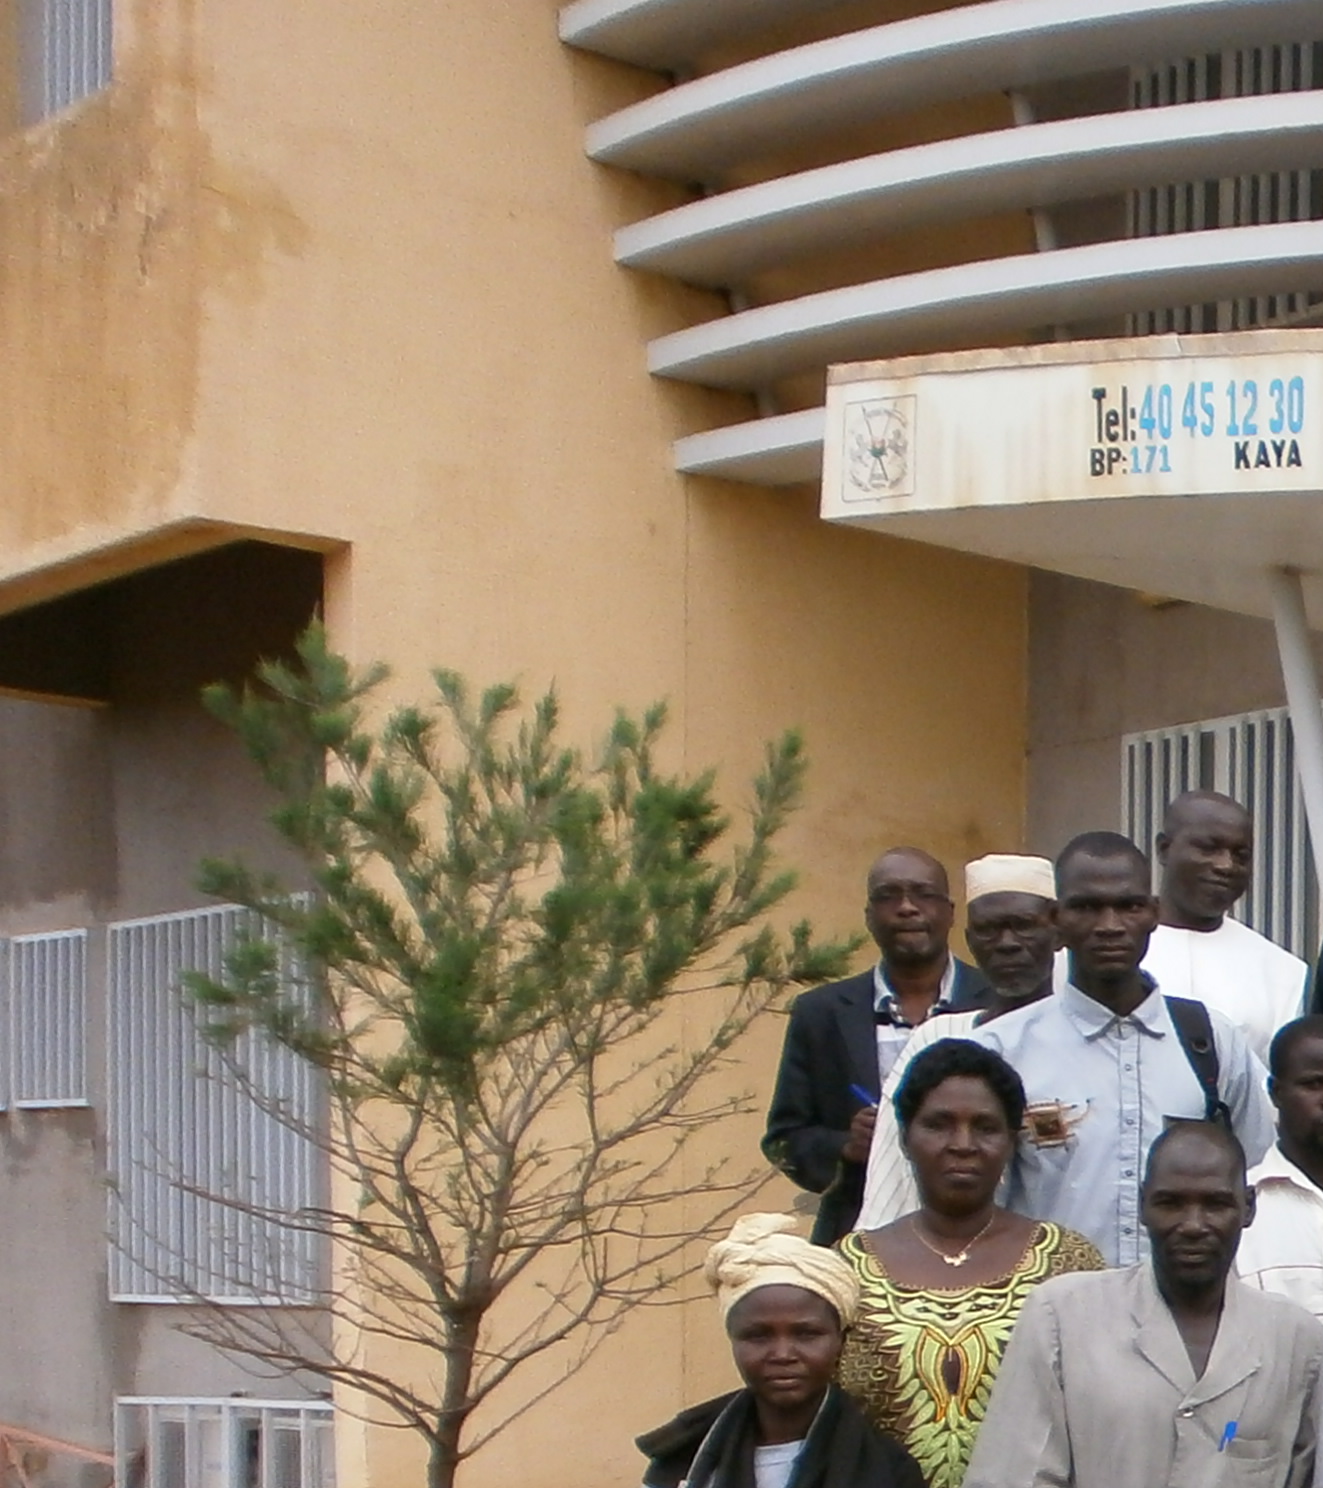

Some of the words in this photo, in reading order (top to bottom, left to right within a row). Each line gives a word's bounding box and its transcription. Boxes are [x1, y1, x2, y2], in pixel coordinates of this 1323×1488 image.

[1182, 381, 1215, 437] 45
[1226, 379, 1258, 436] 12
[1269, 376, 1304, 434] 30
[1234, 438, 1302, 469] KAYA
